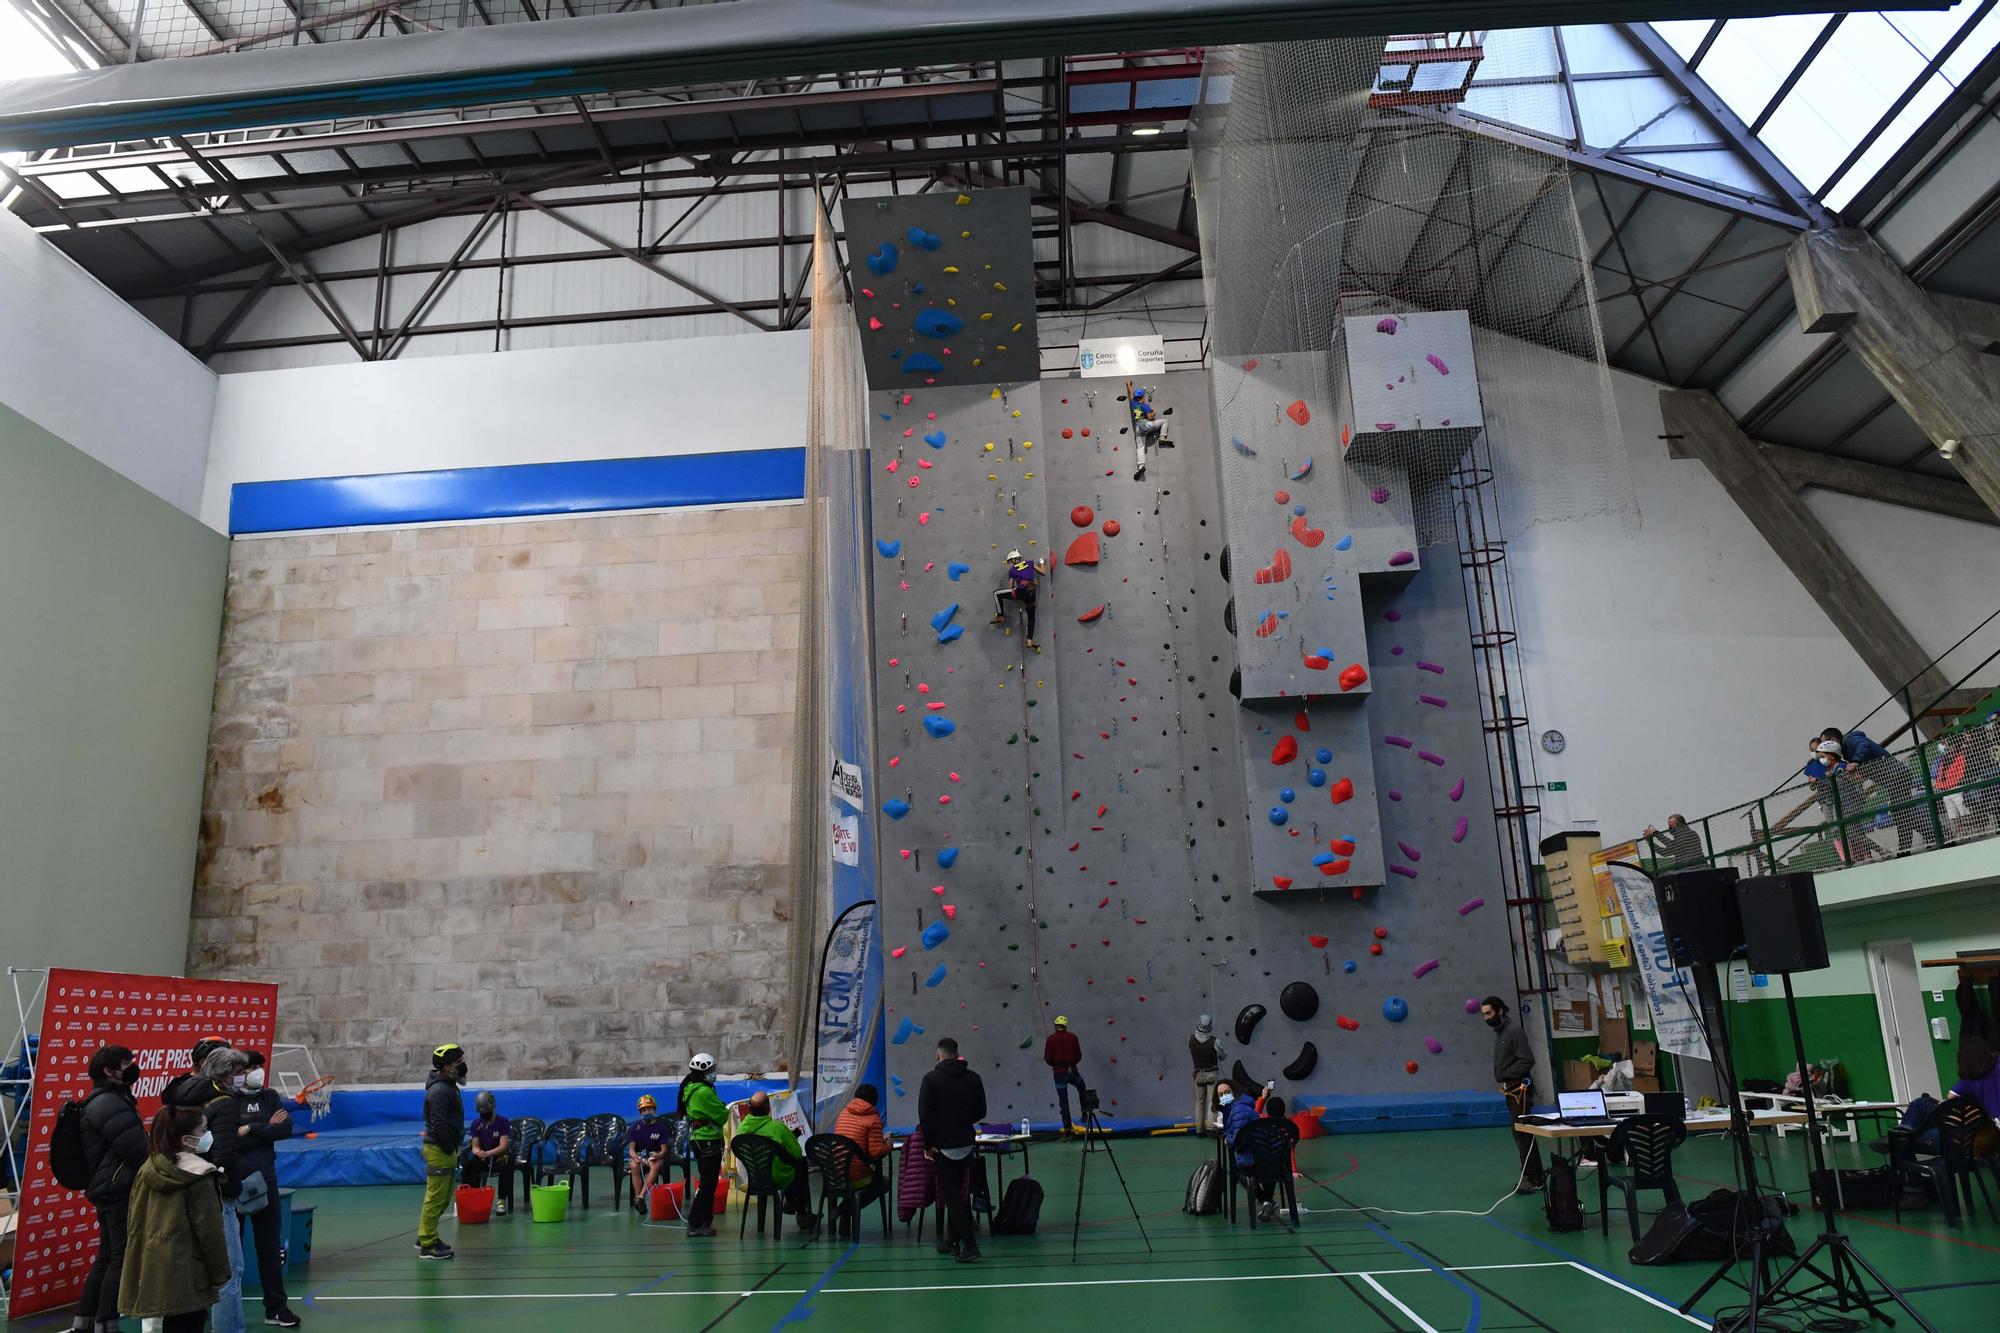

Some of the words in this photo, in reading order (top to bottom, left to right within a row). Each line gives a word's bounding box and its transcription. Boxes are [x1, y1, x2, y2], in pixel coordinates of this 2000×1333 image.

[857, 920, 870, 969] Montañismo
[824, 970, 853, 1028] FGM
[853, 982, 863, 1009] Galega
[849, 1011, 859, 1053] Fedación
[140, 1049, 163, 1070] CHE
[165, 1048, 193, 1069] PRES
[131, 1071, 173, 1098] ORUÑ
